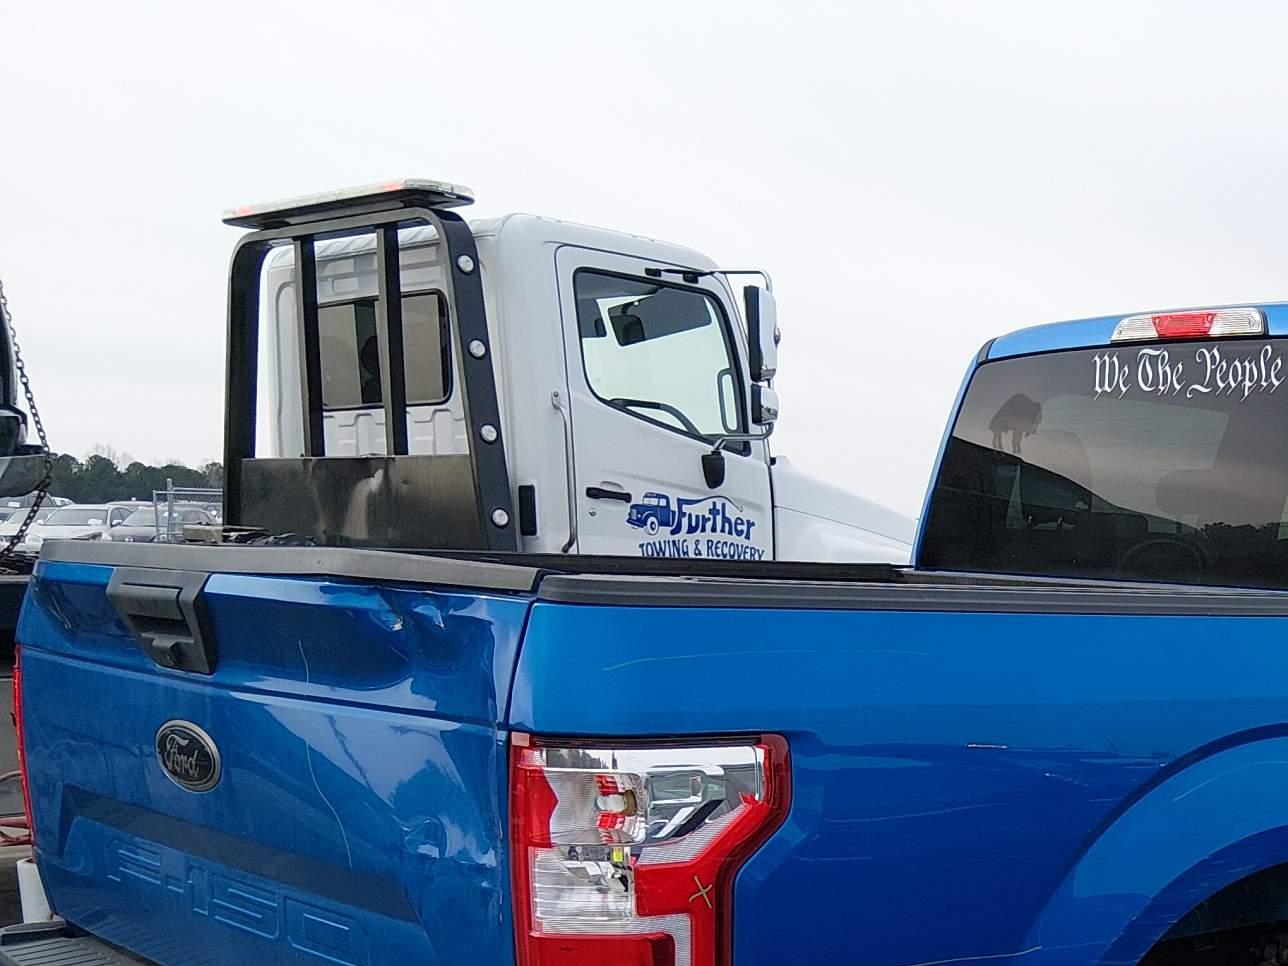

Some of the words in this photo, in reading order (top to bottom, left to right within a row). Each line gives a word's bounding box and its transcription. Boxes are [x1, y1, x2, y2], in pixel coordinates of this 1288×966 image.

[1092, 352, 1132, 400] We
[1137, 347, 1186, 396] The
[1186, 344, 1287, 402] People
[670, 497, 756, 541] Further
[639, 539, 689, 557] TOWING
[693, 541, 703, 557] &
[706, 539, 765, 561] RECOVERY
[165, 733, 200, 778] Ford
